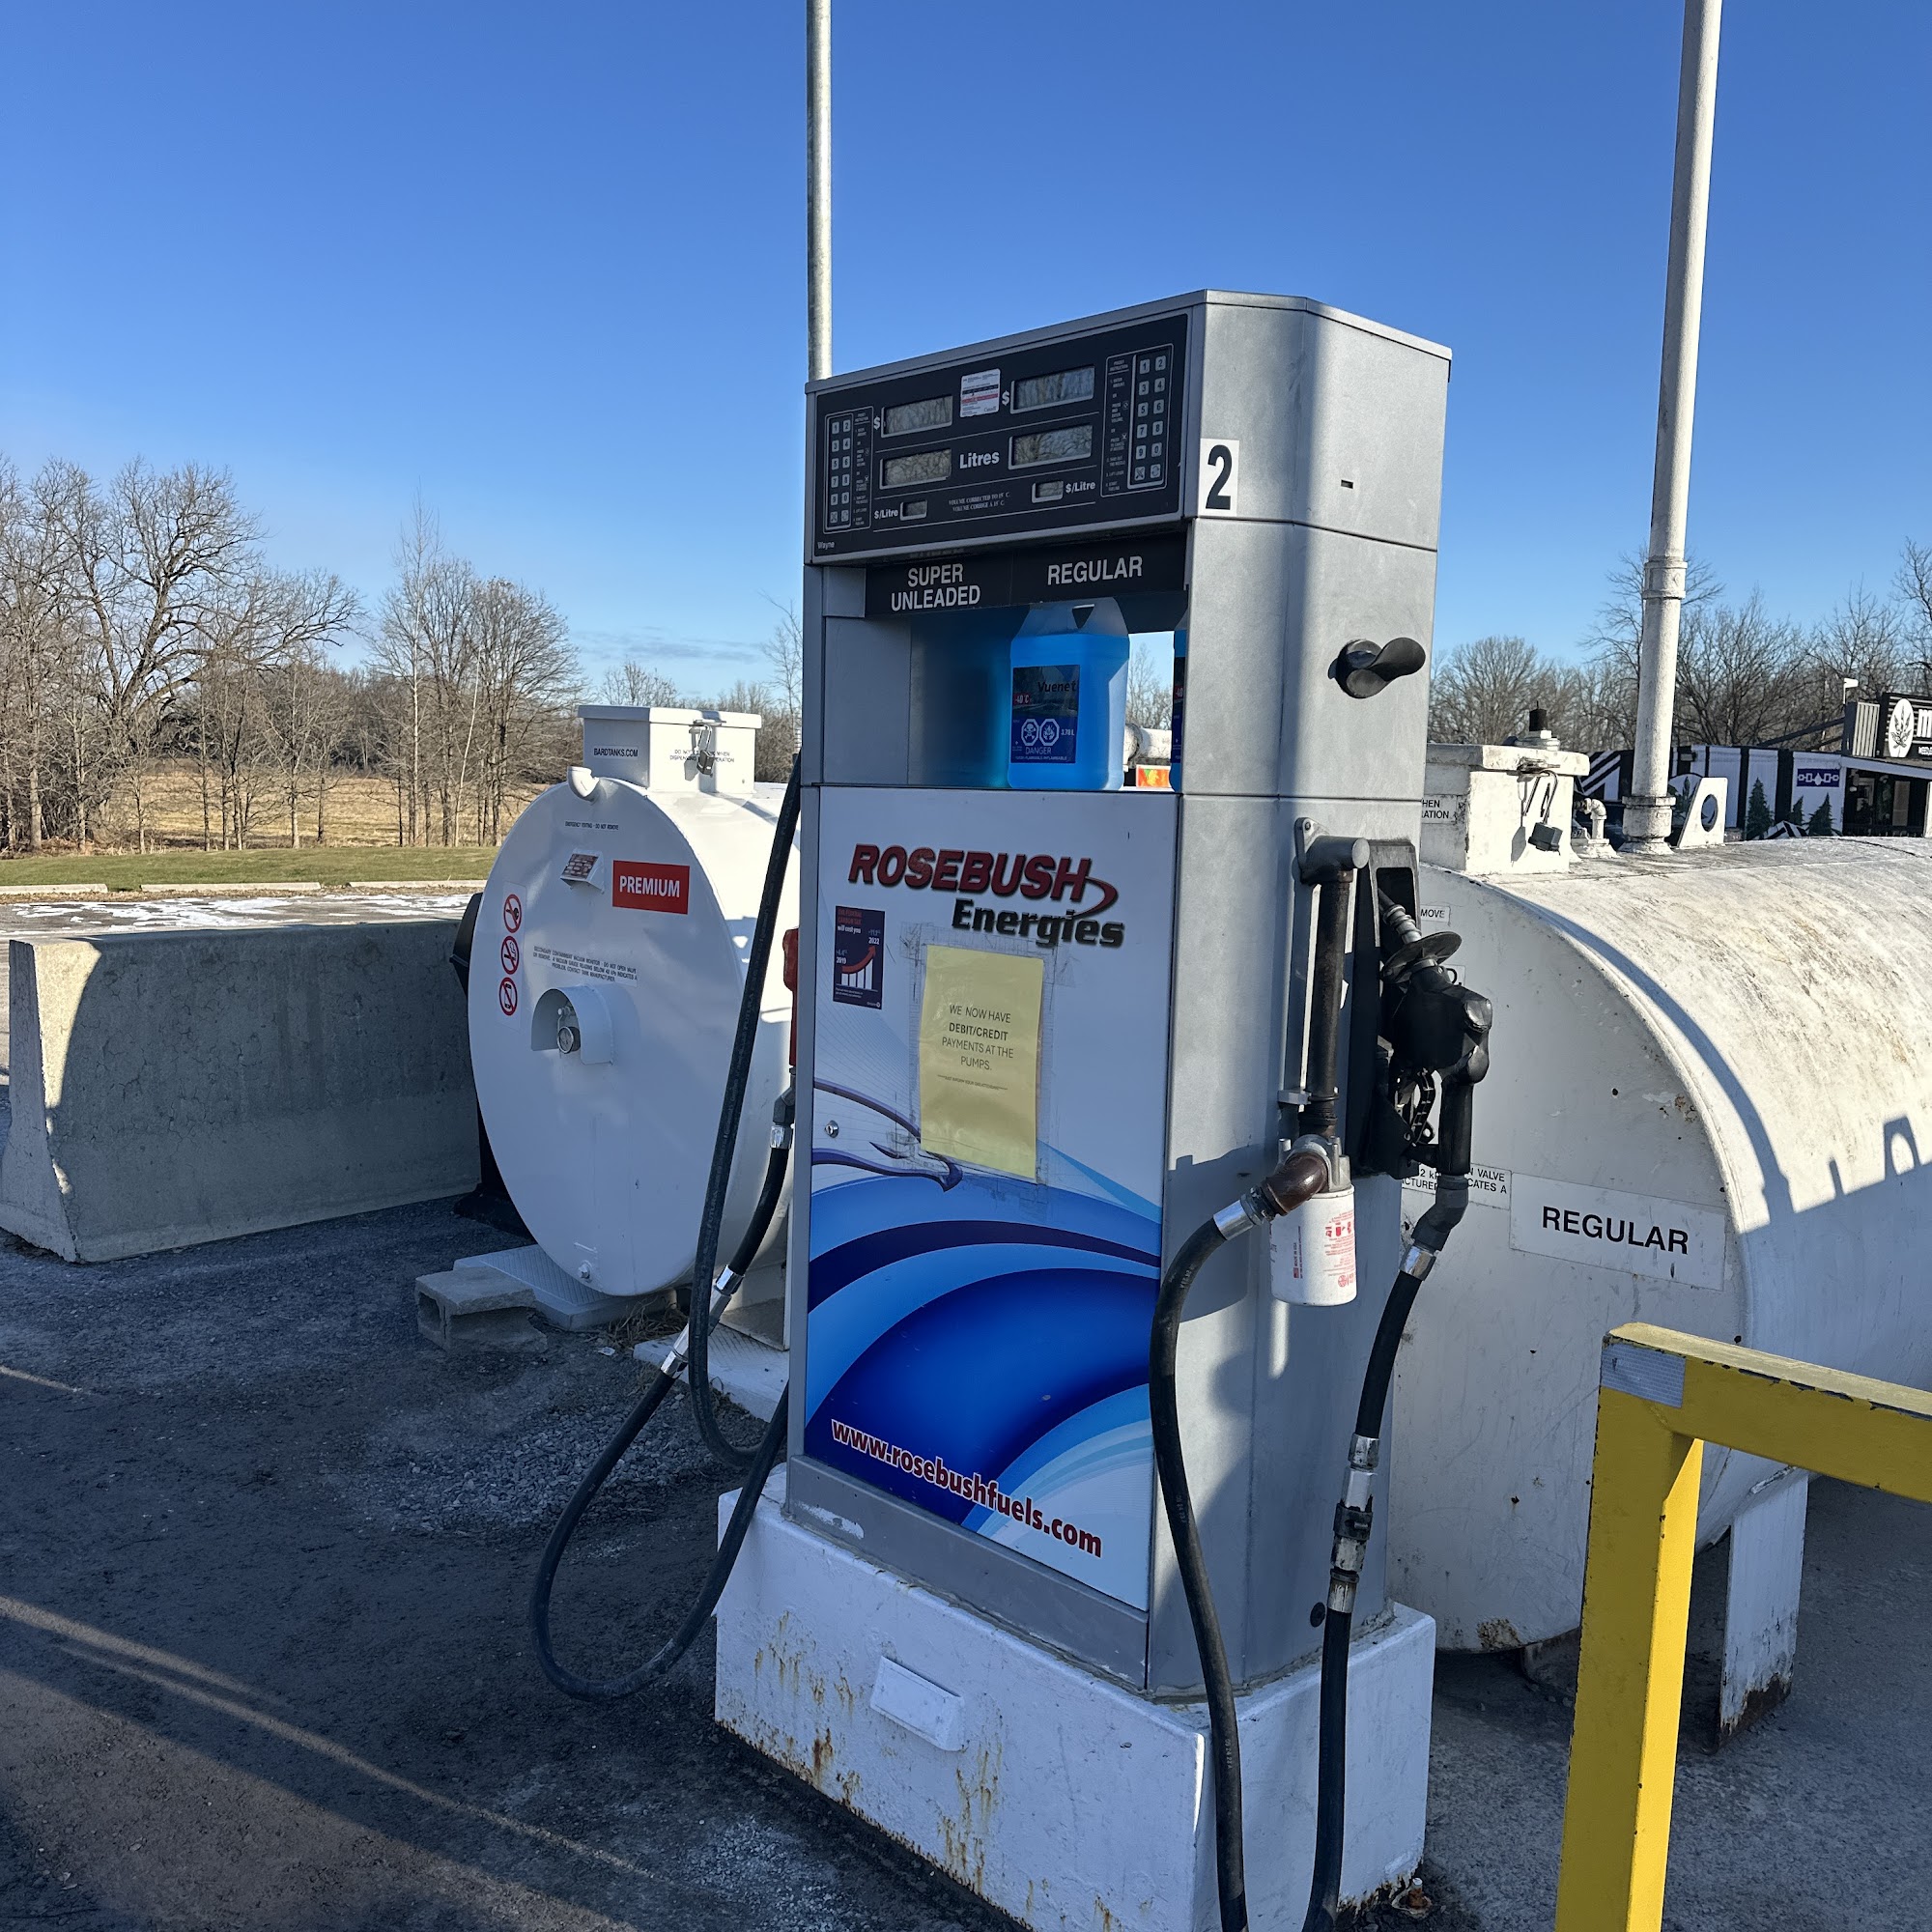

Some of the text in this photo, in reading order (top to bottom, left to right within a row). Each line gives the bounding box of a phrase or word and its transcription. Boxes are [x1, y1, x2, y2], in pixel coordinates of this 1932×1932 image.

[1002, 390, 1009, 406] $
[873, 416, 880, 430] $
[959, 452, 1000, 469] Litres
[1206, 444, 1233, 510] 2
[1065, 481, 1095, 493] $/Litre
[874, 508, 898, 520] $/Litre
[817, 541, 835, 551] Wayne
[907, 563, 964, 587] SUPER
[1047, 555, 1144, 585] REGULAR
[891, 584, 980, 611] UNLEADED
[593, 748, 639, 757] BARDTANKS.COM
[1025, 746, 1051, 754] DANGER
[1422, 810, 1449, 819] ATION
[848, 843, 1093, 902] ROSEBUSH
[619, 875, 680, 898] PREMIUM
[1421, 909, 1445, 918] MOVE
[952, 897, 1125, 949] Energies
[950, 1005, 1010, 1023] WE NOW HAVE
[949, 1022, 1009, 1041] DEBIT/CREDIT
[942, 1037, 1013, 1058] PAYMENTS AT THE
[960, 1056, 992, 1070] PUMPS.
[1478, 1169, 1505, 1181] VALVE
[1500, 1185, 1507, 1194] A
[1542, 1206, 1690, 1255] REGULAR
[831, 1418, 1102, 1558] www.rosebushfuels.com
